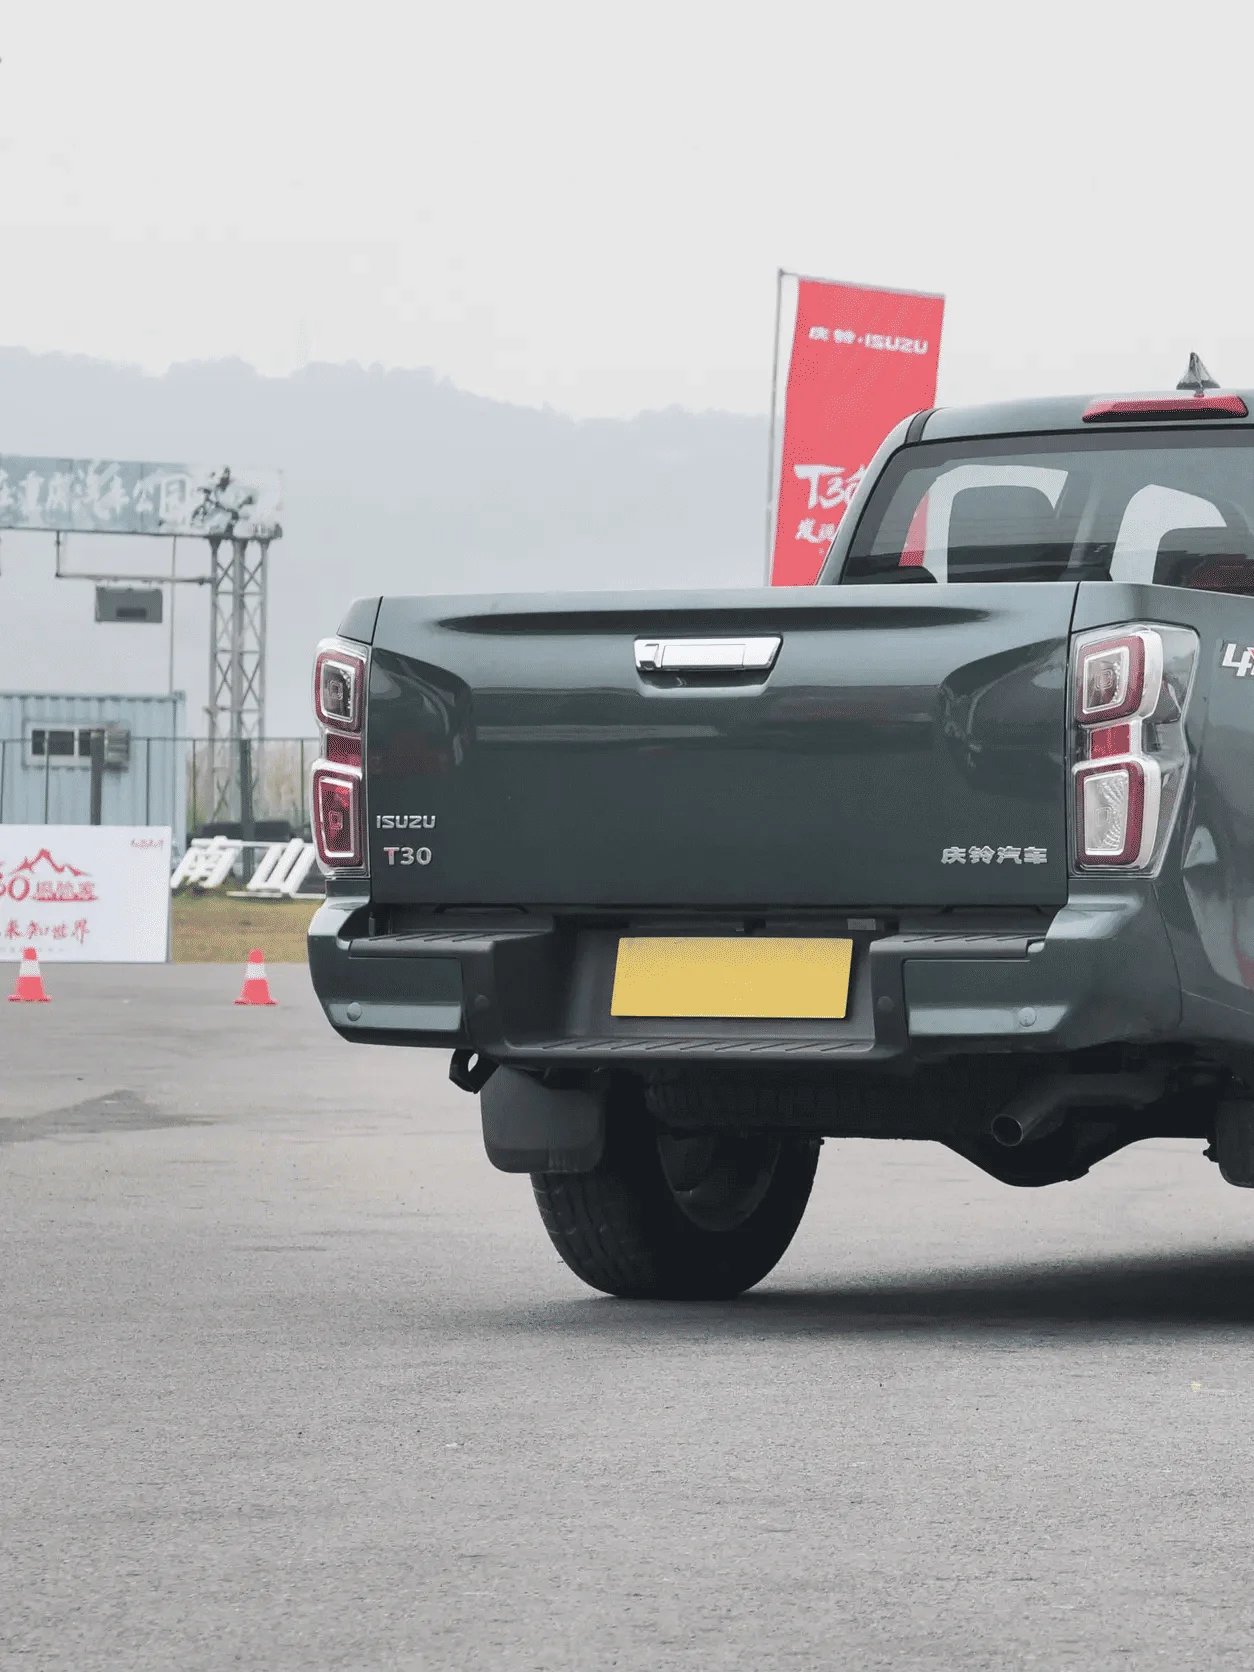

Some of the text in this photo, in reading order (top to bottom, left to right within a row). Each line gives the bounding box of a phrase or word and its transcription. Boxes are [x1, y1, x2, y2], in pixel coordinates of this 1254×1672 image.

[376, 815, 436, 829] ISUZU
[383, 847, 432, 866] T30
[940, 845, 1048, 865] 庆铃汽车
